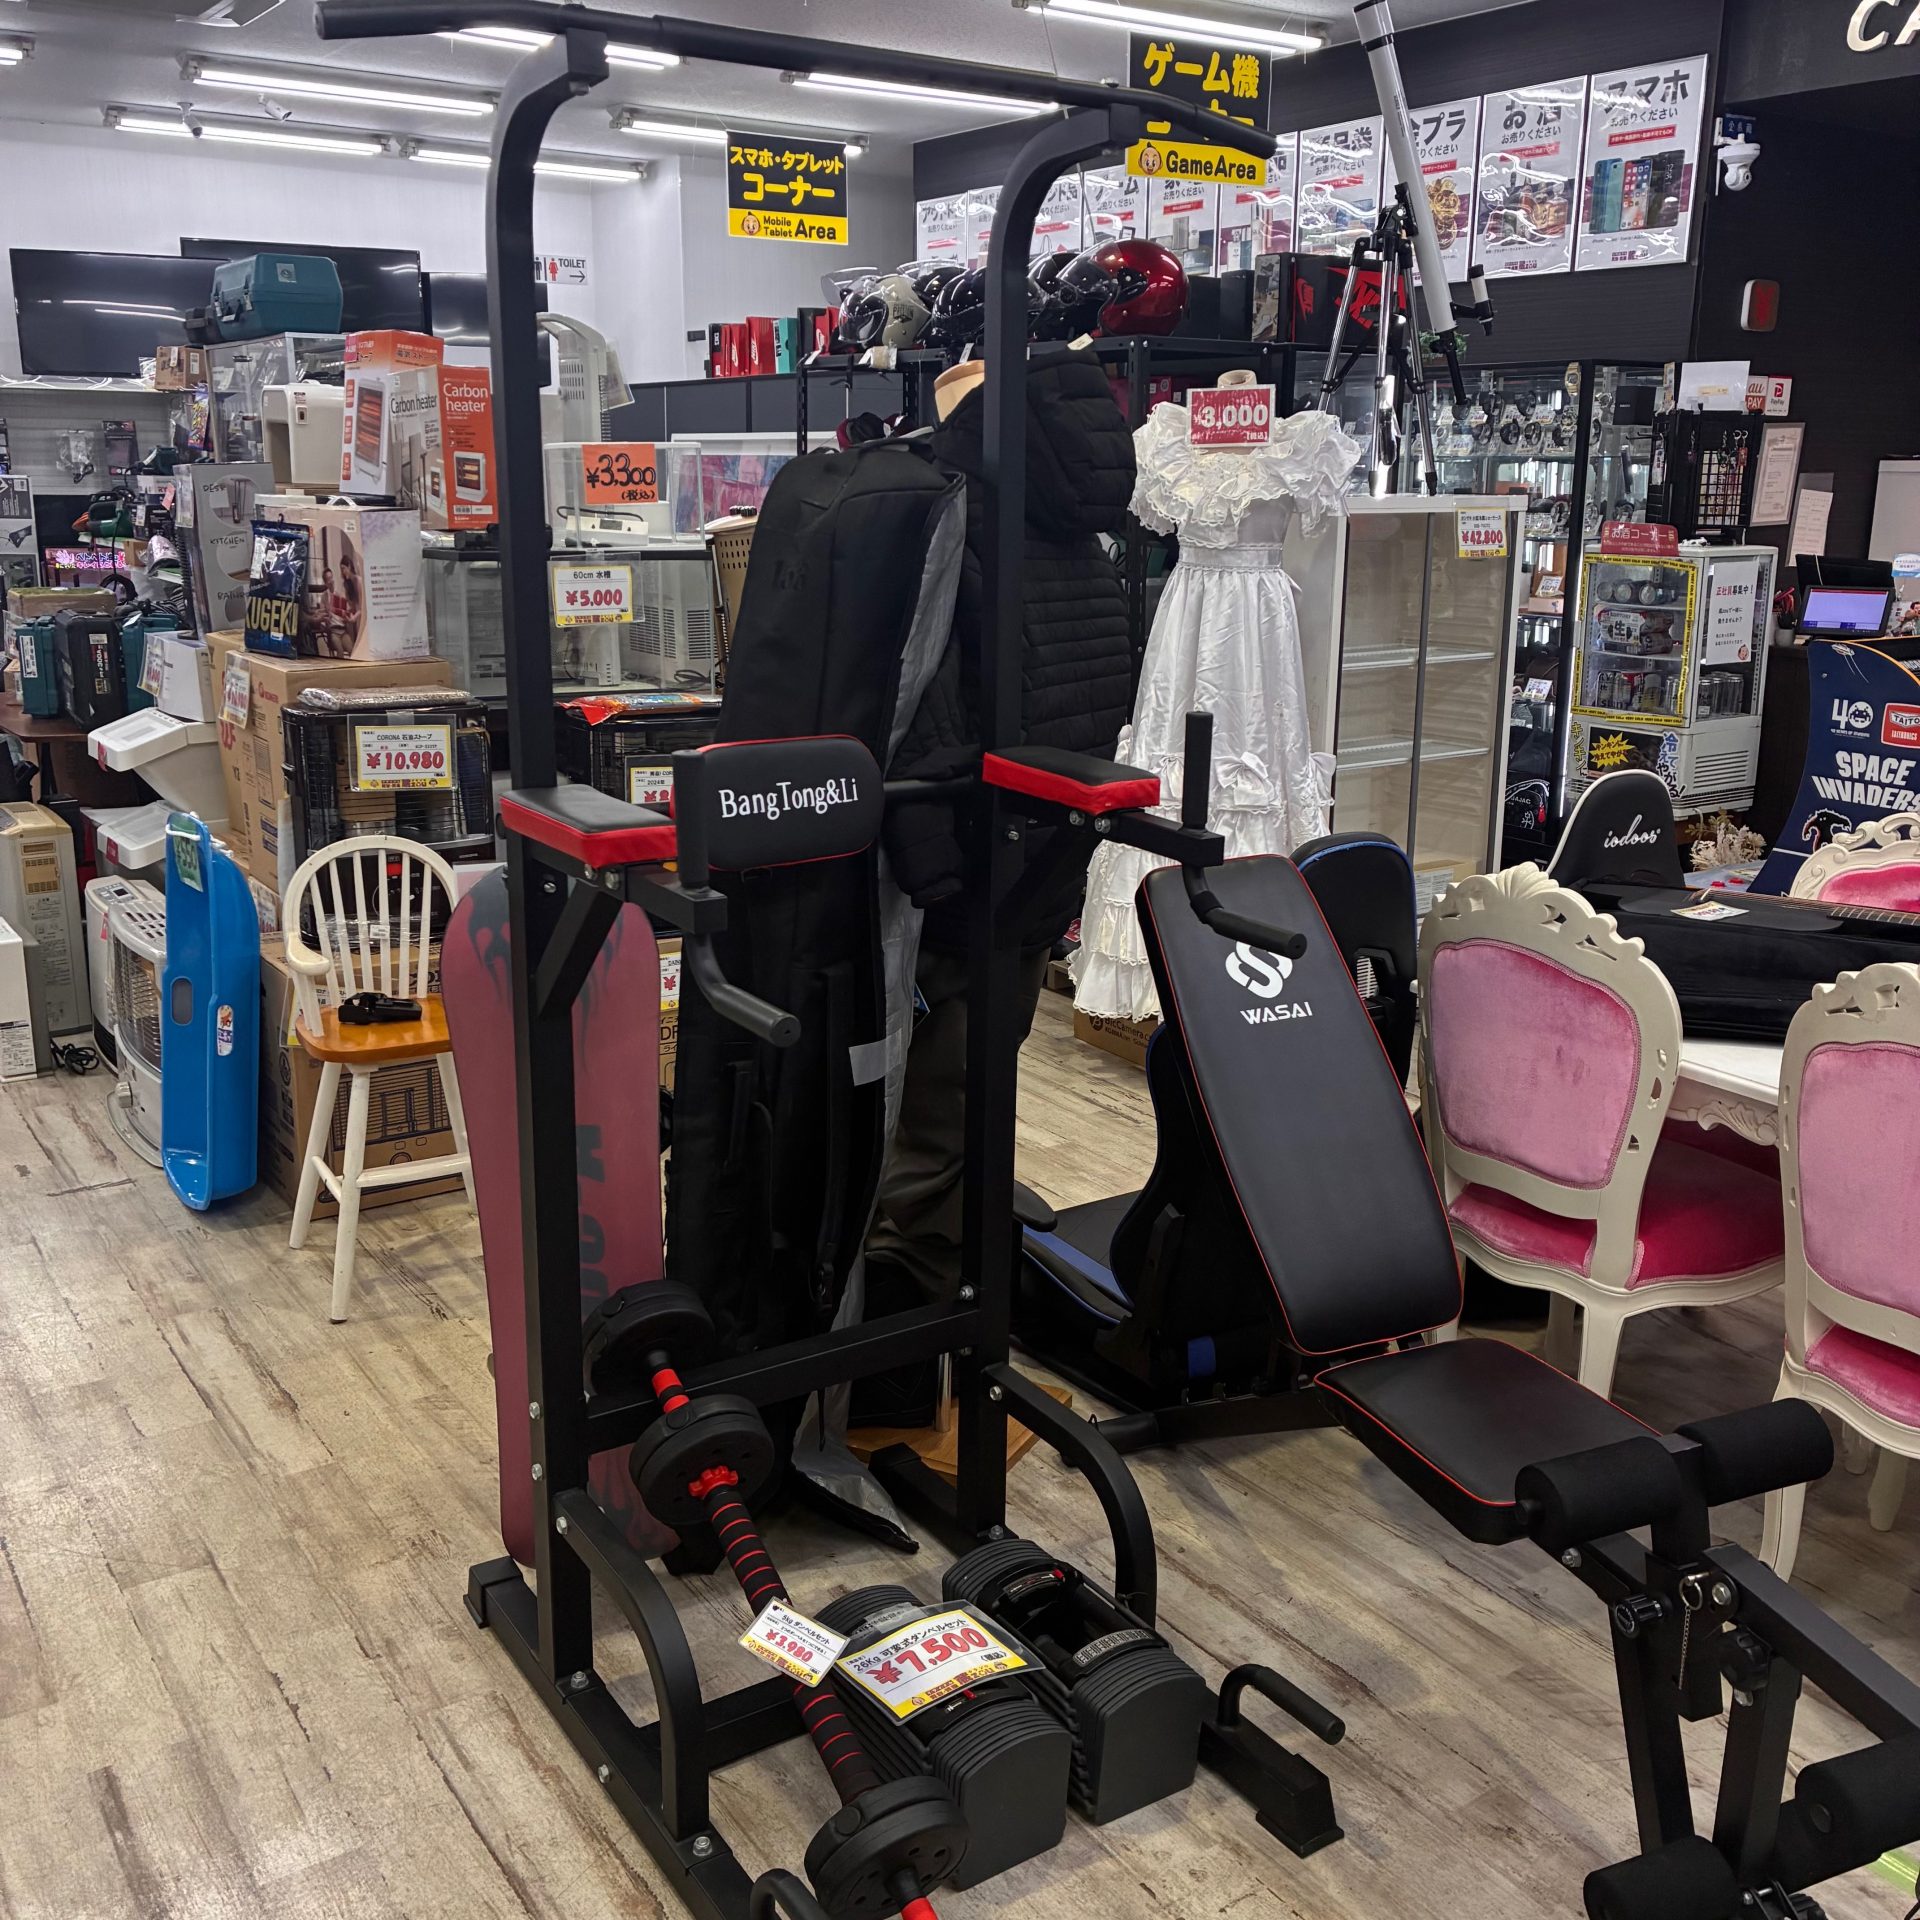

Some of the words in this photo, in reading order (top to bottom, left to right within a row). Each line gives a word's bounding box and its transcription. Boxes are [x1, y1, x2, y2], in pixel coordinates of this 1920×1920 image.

[1144, 42, 1260, 98] ゲーム機
[1501, 126, 1562, 144] お売りください
[730, 146, 844, 175] スマホ・タブレット
[1420, 144, 1459, 158] りください
[1166, 150, 1257, 181] GameArea
[743, 172, 835, 206] コーナー
[1163, 187, 1205, 200] お売りください
[763, 216, 792, 227] Mobile
[764, 226, 792, 237] Tablet
[795, 219, 837, 241] Area
[558, 258, 586, 269] TOILET
[443, 383, 488, 399] Carbon
[1748, 382, 1765, 394] au
[391, 394, 416, 414] Carbon
[416, 393, 438, 413] heater
[445, 399, 486, 412] heater
[1747, 397, 1763, 409] PAY
[587, 452, 657, 489] ¥3,300
[210, 536, 246, 545] KITCHEN
[1461, 529, 1503, 545] ¥42,800
[1611, 524, 1668, 541] お酒コーナー
[573, 571, 593, 580] 60cm
[565, 588, 623, 607] ¥5,000
[1614, 620, 1627, 638] 生
[1893, 714, 1920, 727] TAITO
[1570, 721, 1588, 777] キンキンに
[366, 751, 444, 770] ¥10,980
[1835, 750, 1916, 787] SPACE
[718, 778, 859, 821] BangTong&Li
[1603, 814, 1661, 849] iodoos
[1239, 1001, 1313, 1025] WASAI
[781, 1614, 793, 1624] 5kg
[793, 1621, 831, 1645] ダンベルセット
[765, 1628, 814, 1663] ¥3,980
[853, 1655, 882, 1673] 26Kg
[879, 1618, 967, 1658] 可変式ダンベルセット
[864, 1627, 989, 1686] ¥7,500
